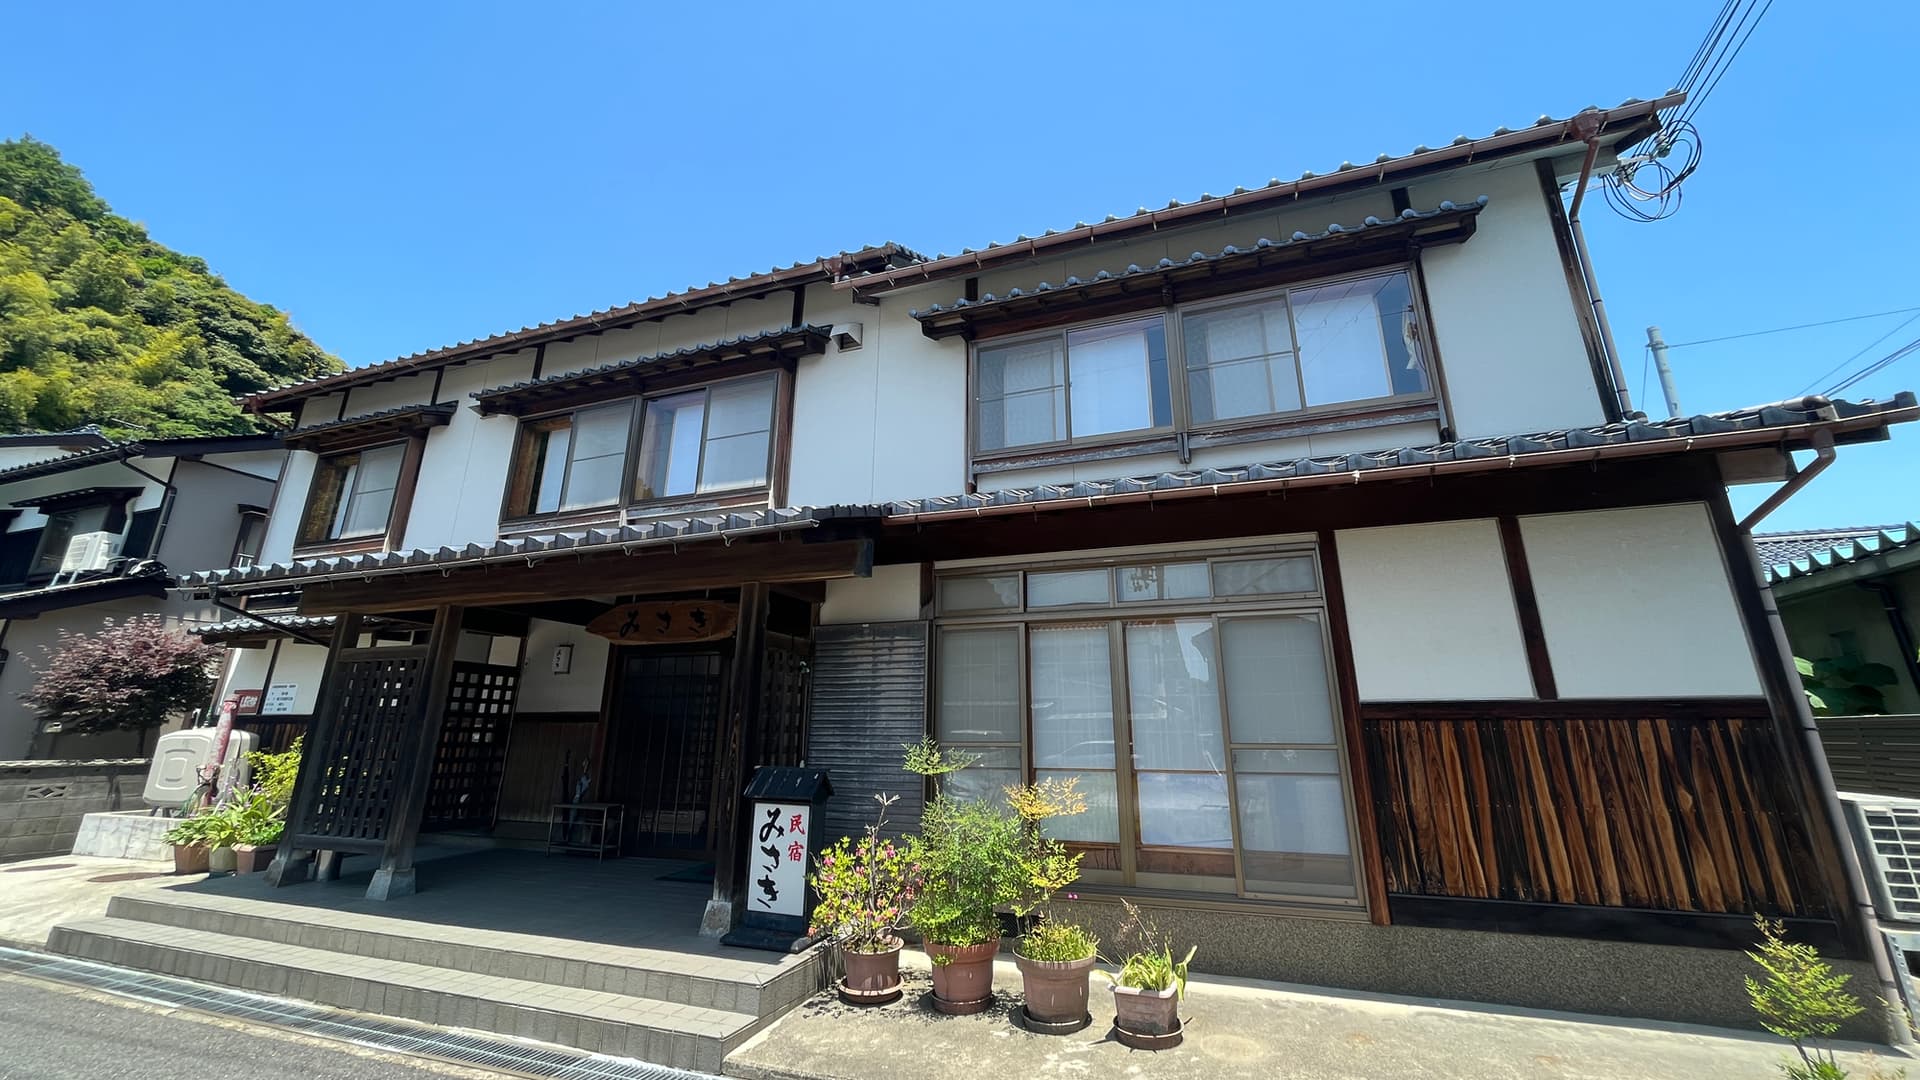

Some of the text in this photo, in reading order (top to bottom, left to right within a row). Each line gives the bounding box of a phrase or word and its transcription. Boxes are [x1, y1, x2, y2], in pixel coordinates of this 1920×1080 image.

[620, 608, 706, 637] みさき
[757, 808, 785, 908] みさき
[788, 814, 805, 862] 民宿
